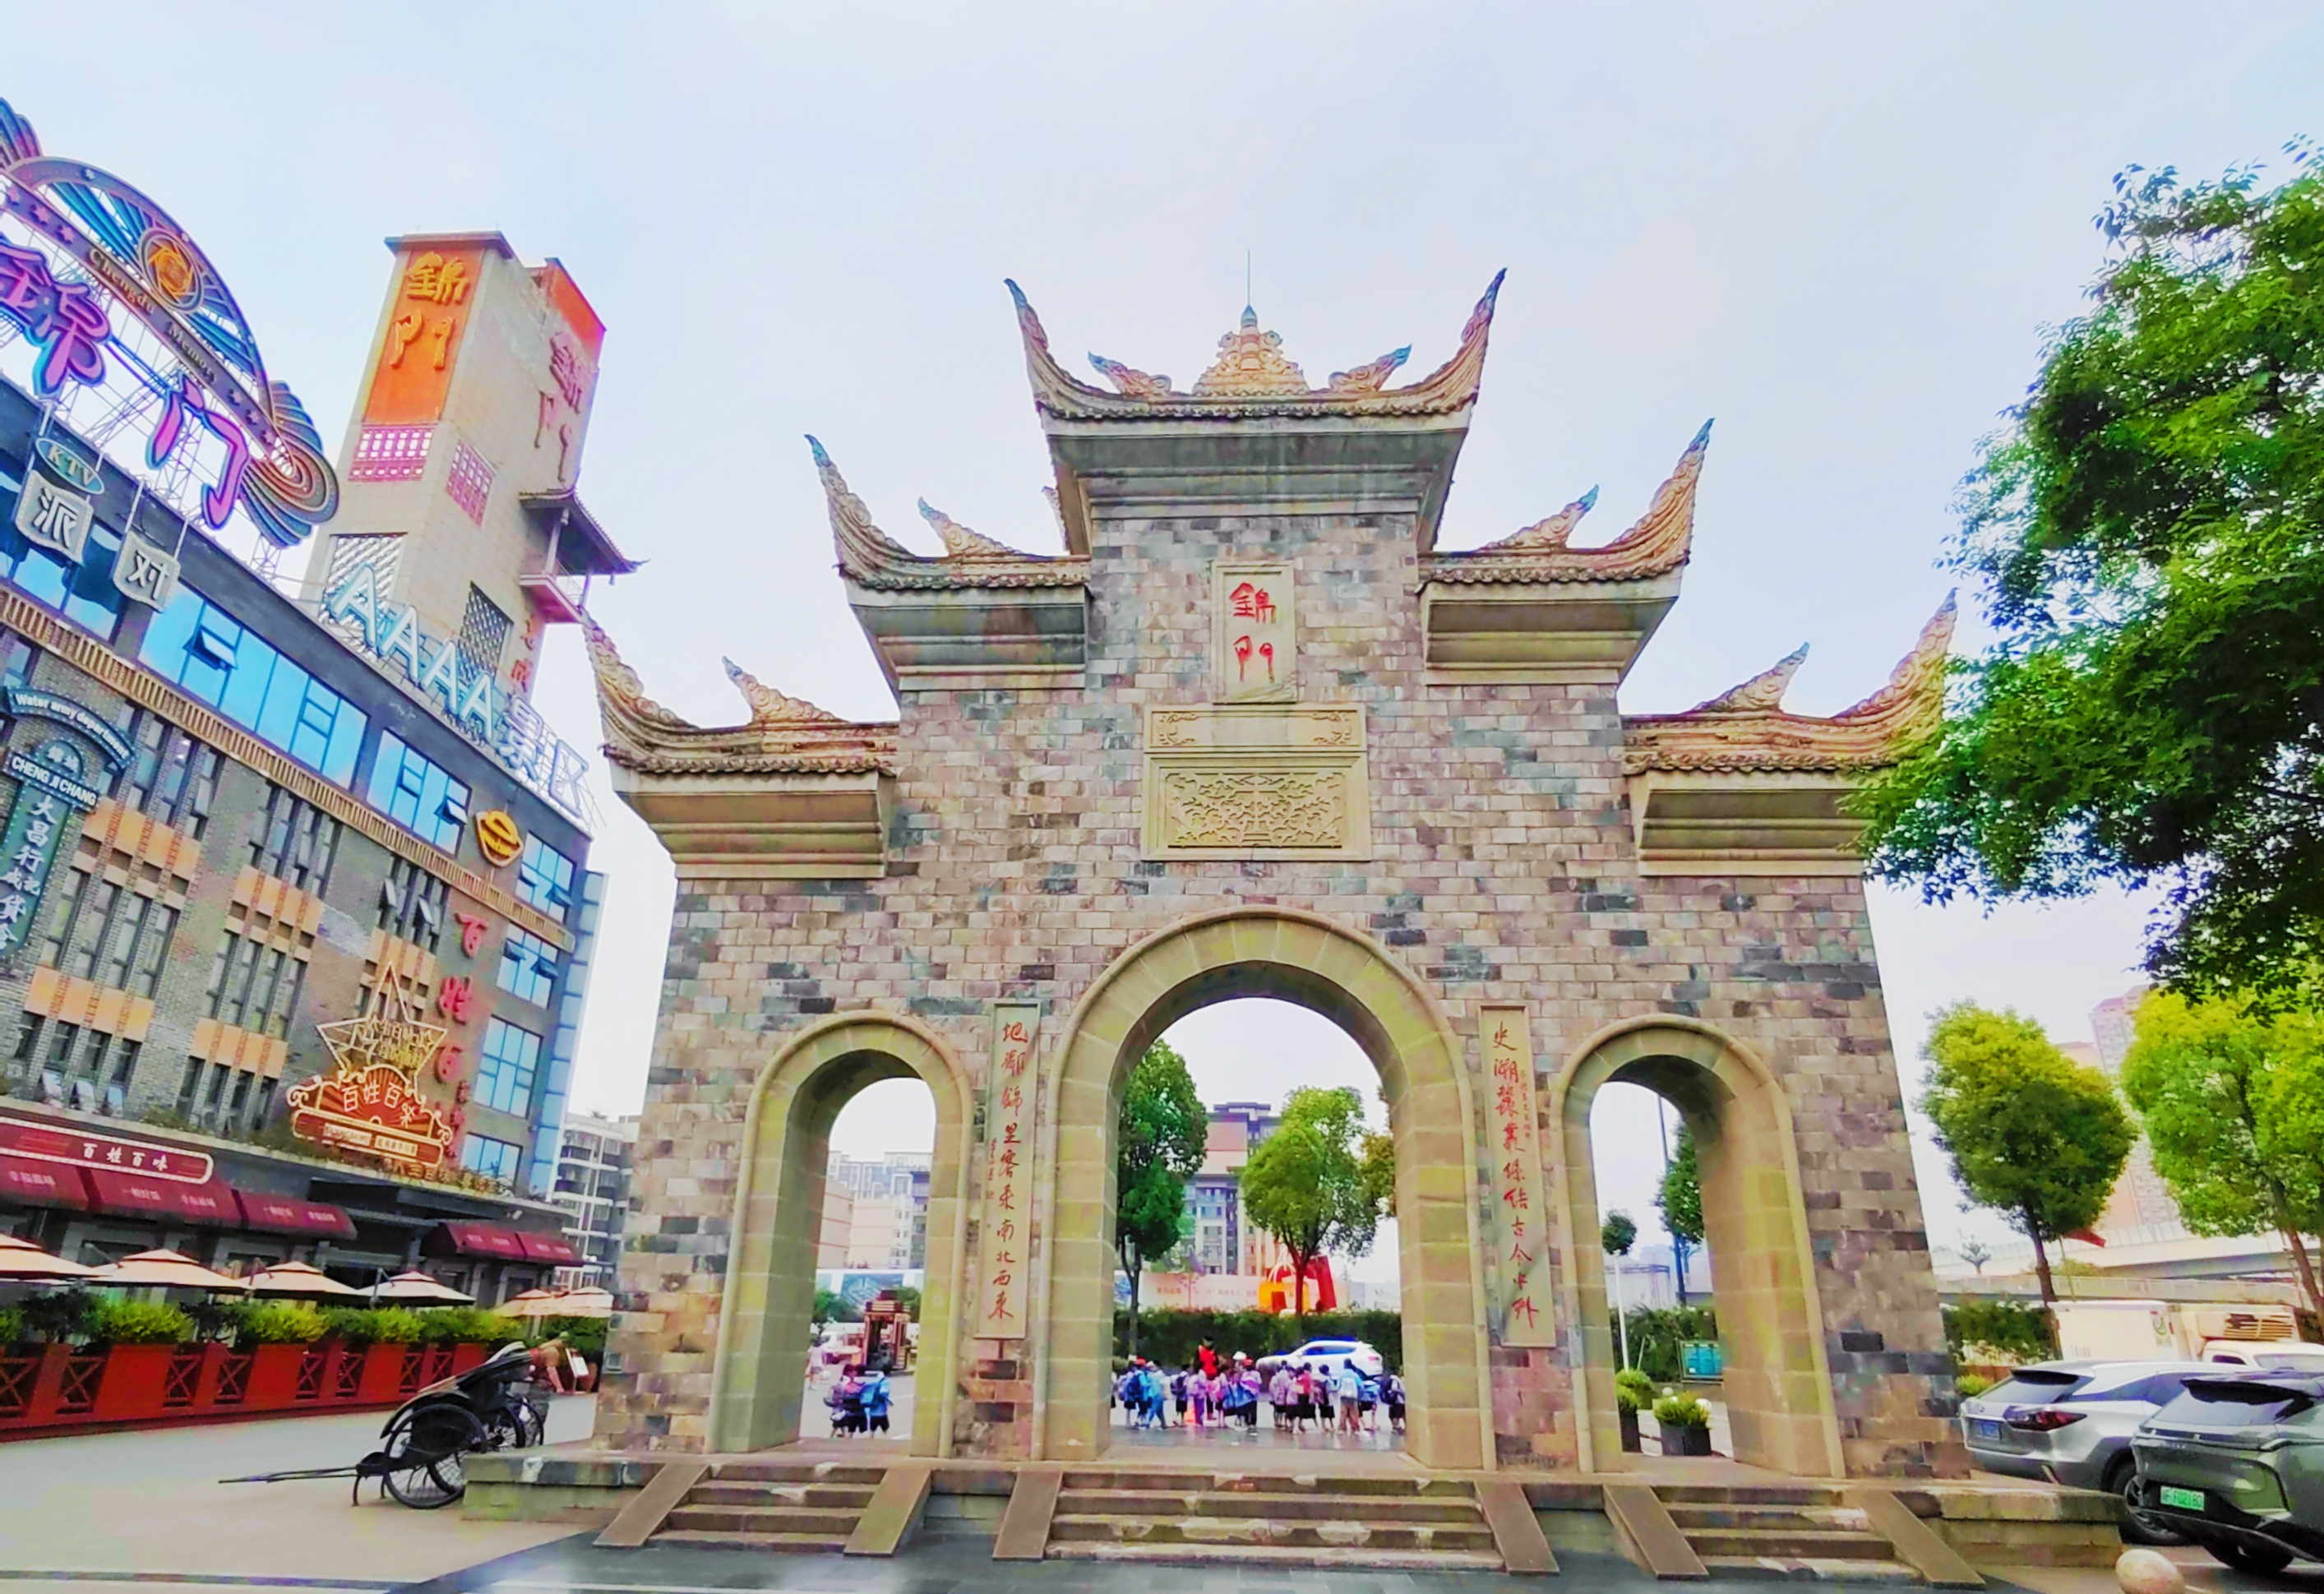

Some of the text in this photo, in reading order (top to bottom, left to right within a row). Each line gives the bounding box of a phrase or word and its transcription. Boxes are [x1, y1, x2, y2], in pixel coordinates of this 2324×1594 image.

[86, 249, 219, 386] Chengdu Memory
[48, 444, 95, 487] KTV
[16, 693, 130, 760] Water army department
[12, 755, 99, 806] CHENG JI CHANG
[12, 794, 57, 873] 大昌行
[341, 1079, 416, 1129] 百姓百味
[83, 1143, 169, 1172] 百姓百味
